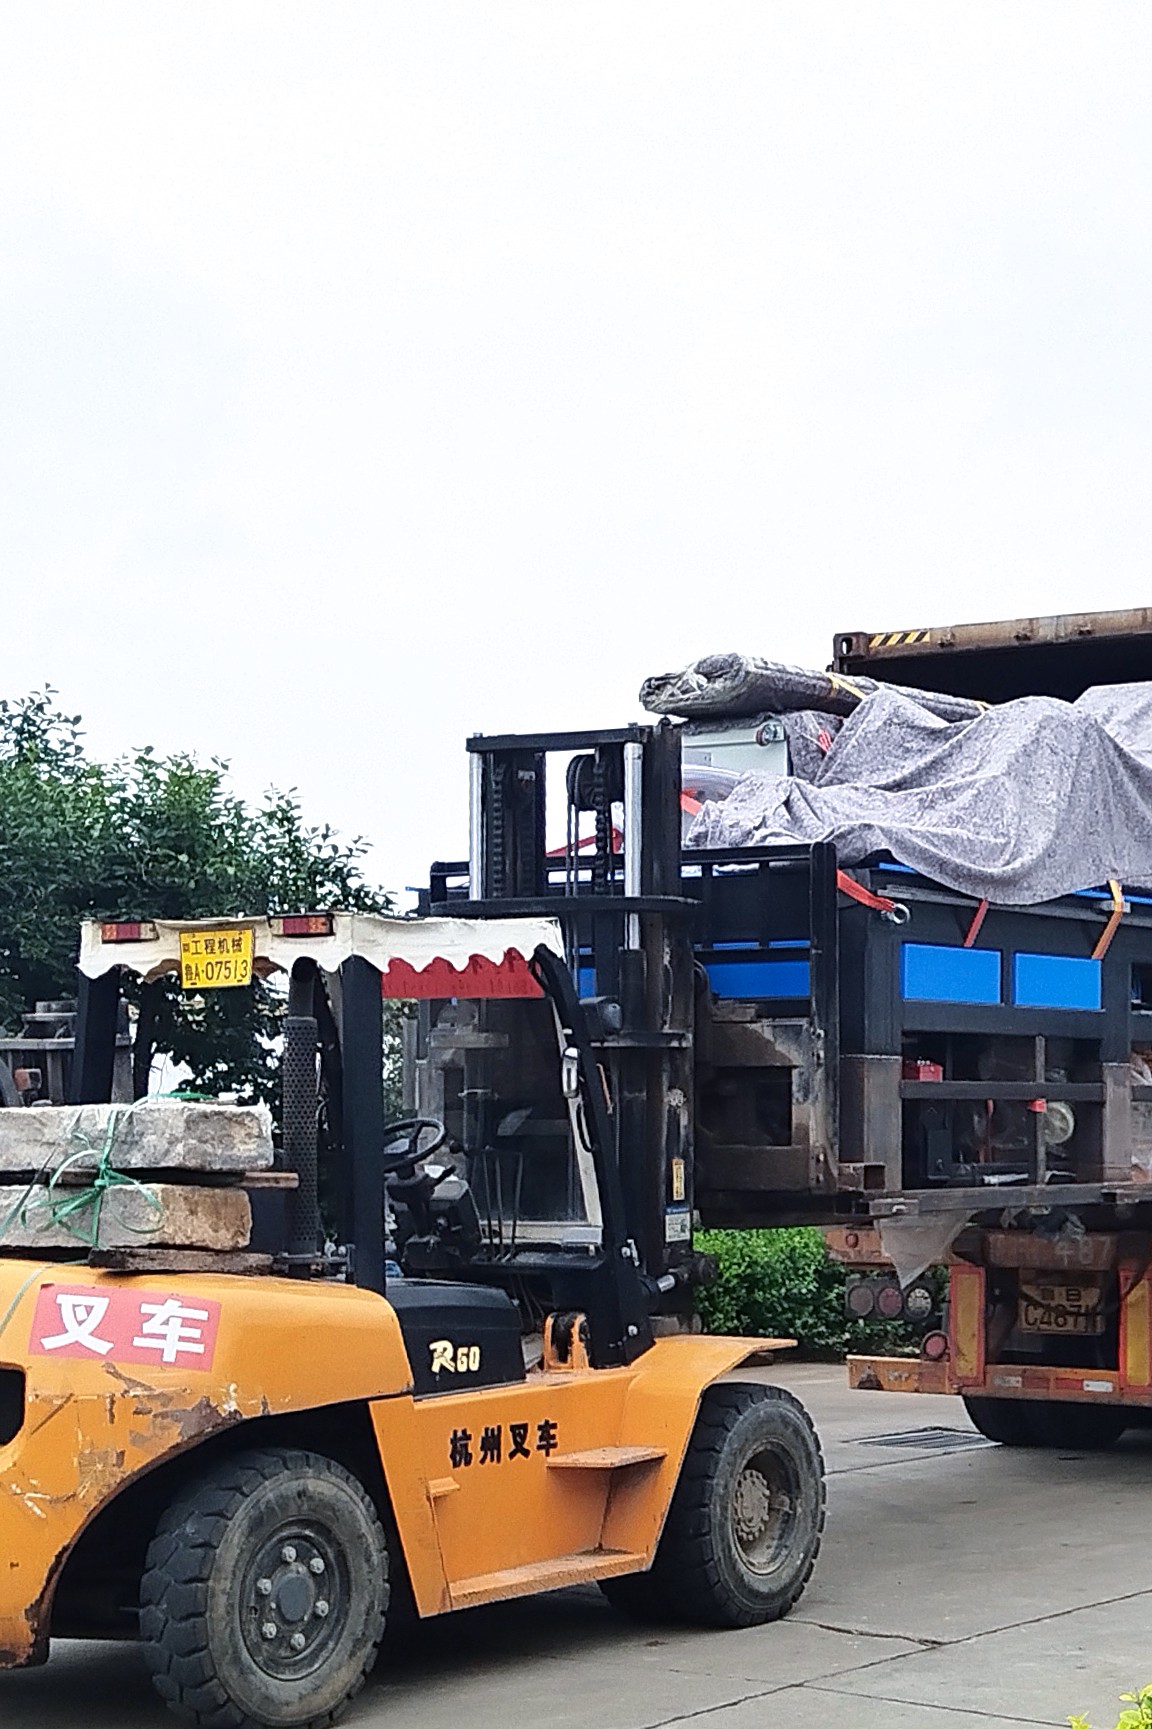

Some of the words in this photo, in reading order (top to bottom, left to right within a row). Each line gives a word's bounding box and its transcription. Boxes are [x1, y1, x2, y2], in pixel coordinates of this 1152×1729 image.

[191, 937, 242, 955] 工程机械
[40, 1293, 209, 1362] 叉车
[428, 1339, 481, 1374] R60
[449, 1418, 559, 1469] 杭州叉车
